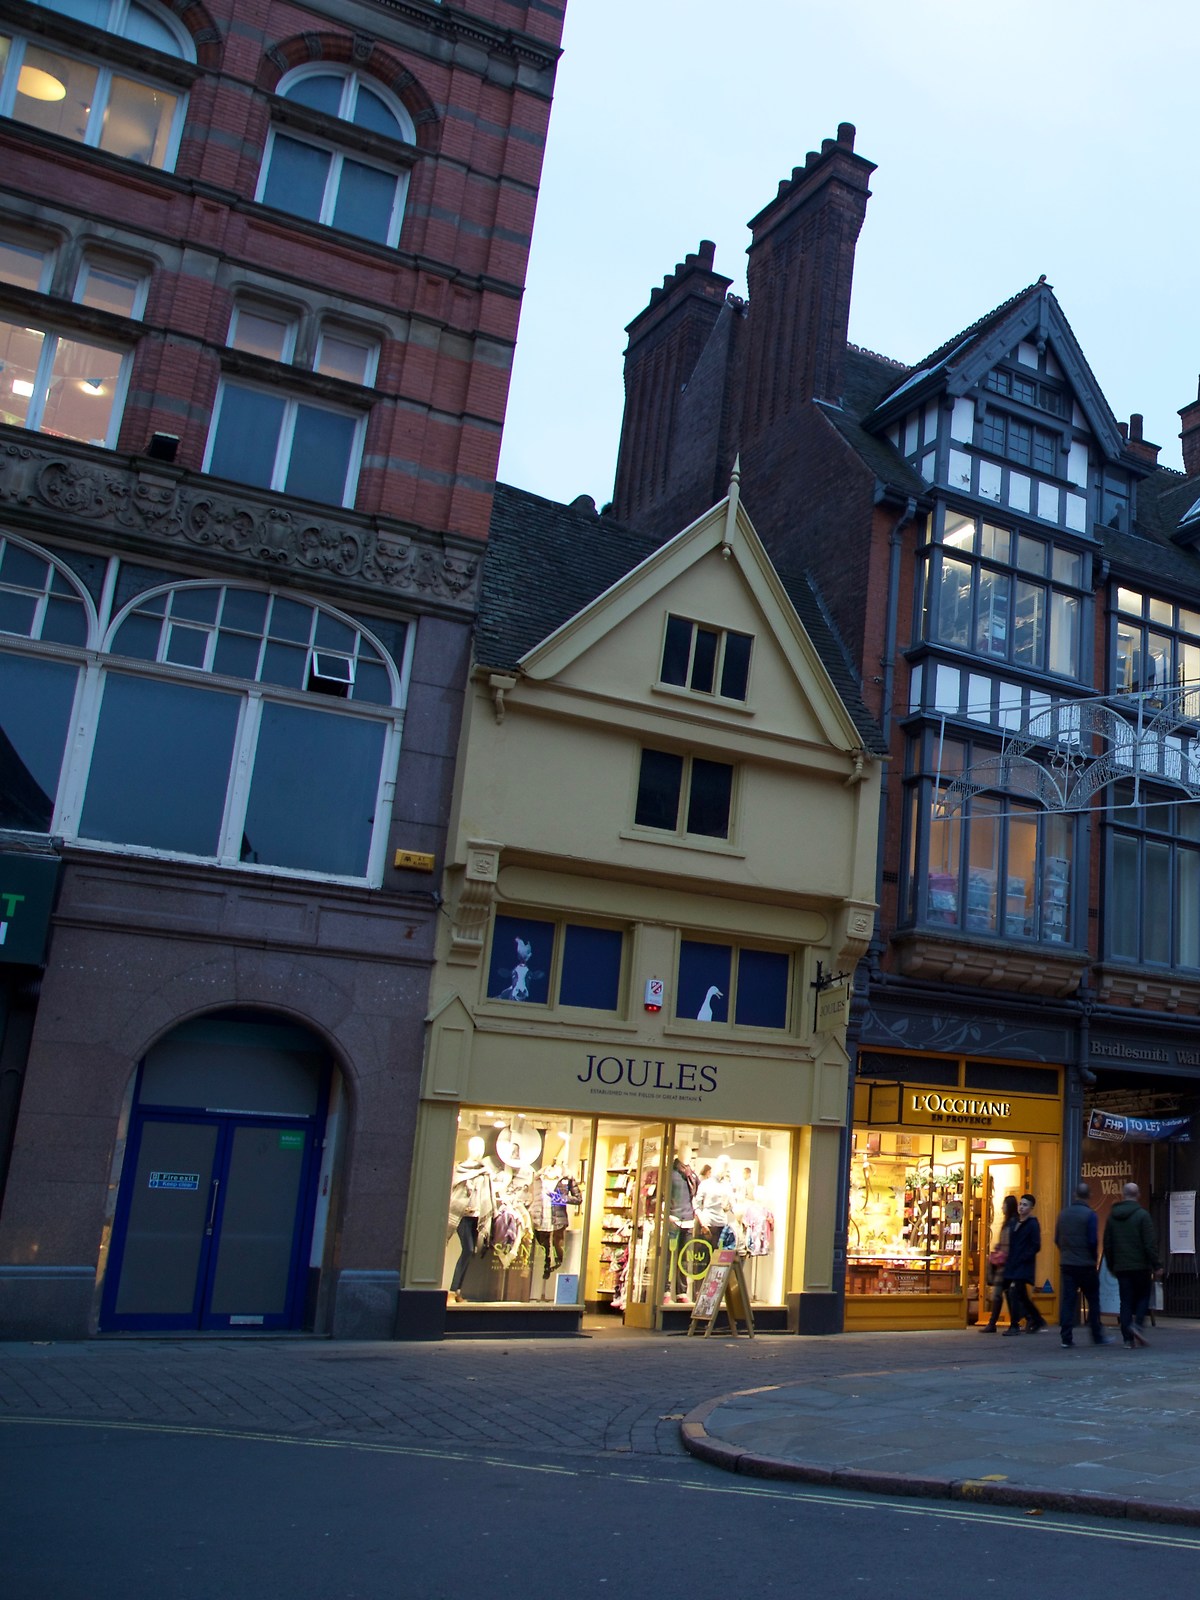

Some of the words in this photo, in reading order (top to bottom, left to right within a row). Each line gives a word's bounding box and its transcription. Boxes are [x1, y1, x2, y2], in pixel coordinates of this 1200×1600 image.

[1090, 1040, 1169, 1062] Bridlesmith
[577, 1054, 718, 1093] JOULES
[911, 1093, 1012, 1118] L'OCCITANE
[931, 1113, 944, 1122] EN
[946, 1115, 992, 1126] PROVENCE
[1104, 1118, 1124, 1131] FHP
[1130, 1119, 1143, 1130] TO
[1145, 1121, 1161, 1132] LET
[1101, 1179, 1125, 1195] Wal
